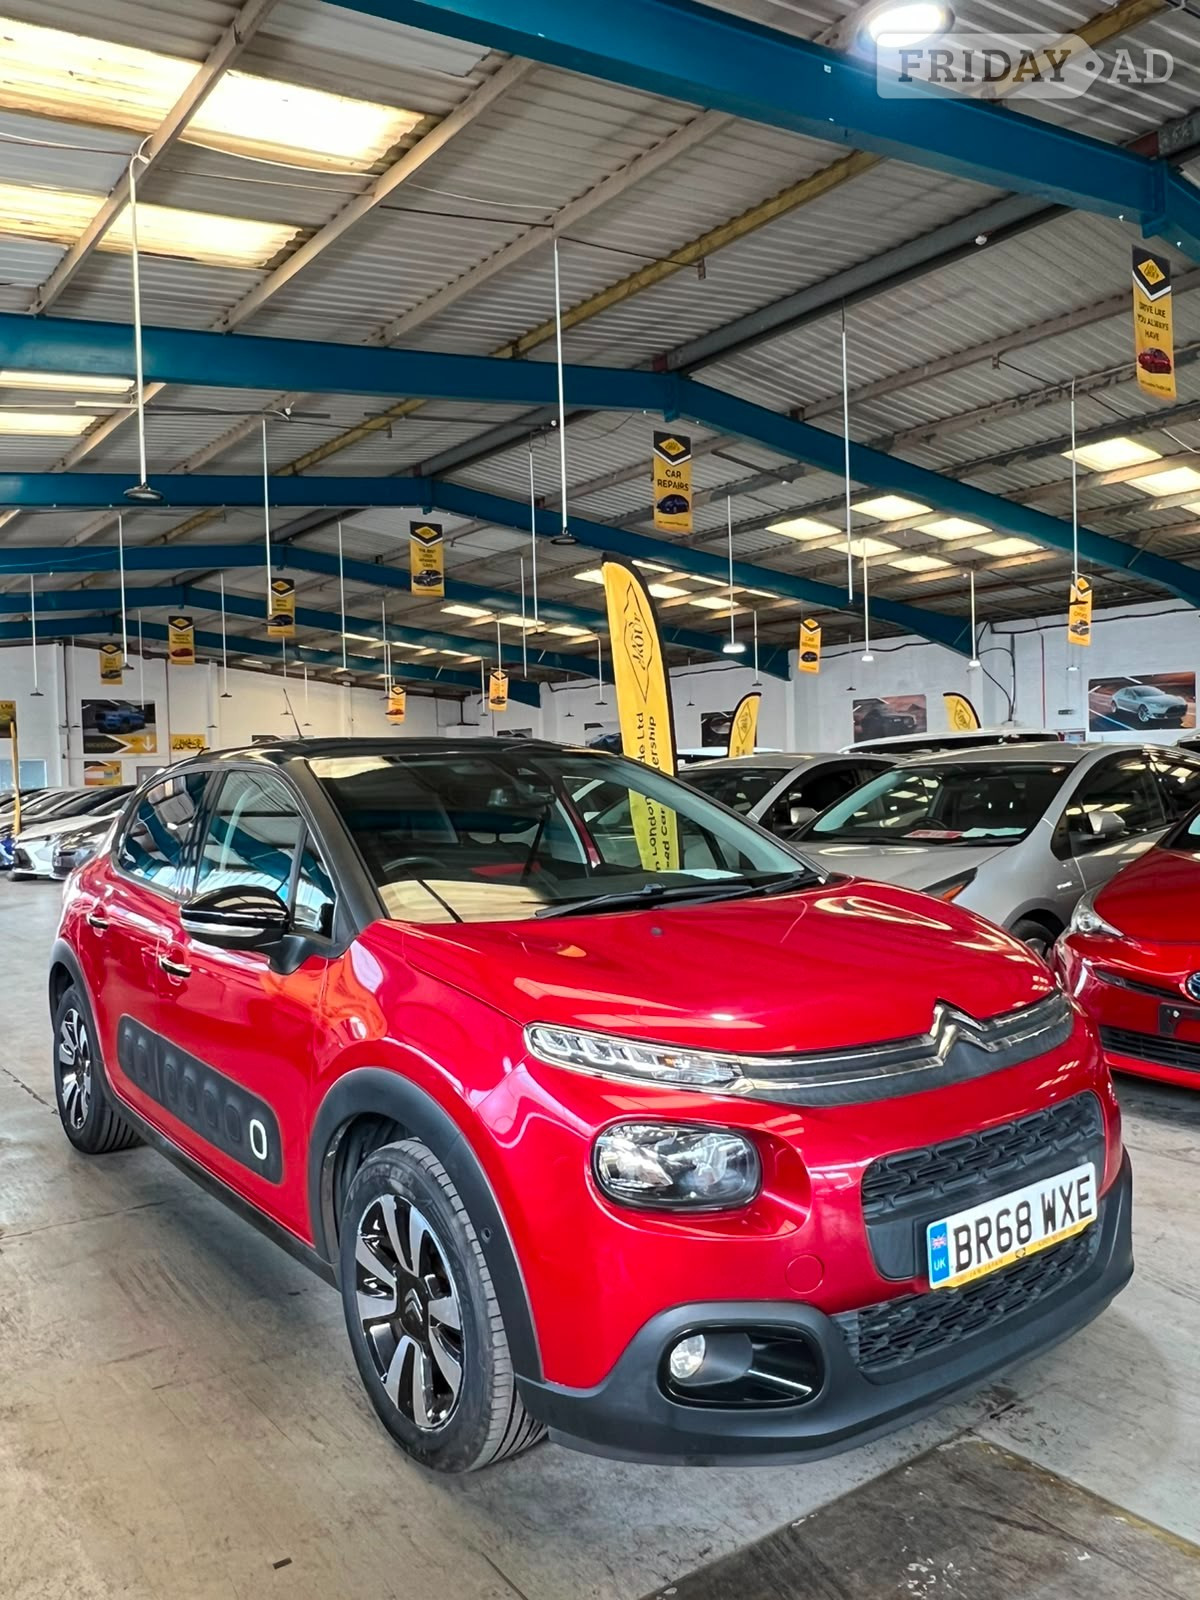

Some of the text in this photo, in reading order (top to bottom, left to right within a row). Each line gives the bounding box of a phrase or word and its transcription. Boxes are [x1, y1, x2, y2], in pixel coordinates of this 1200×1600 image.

[665, 469, 682, 479] CAR
[657, 479, 689, 491] REPAIRS
[636, 712, 645, 740] Ltd
[953, 1175, 1093, 1273] BR68 WXE
[933, 1256, 947, 1271] UK
